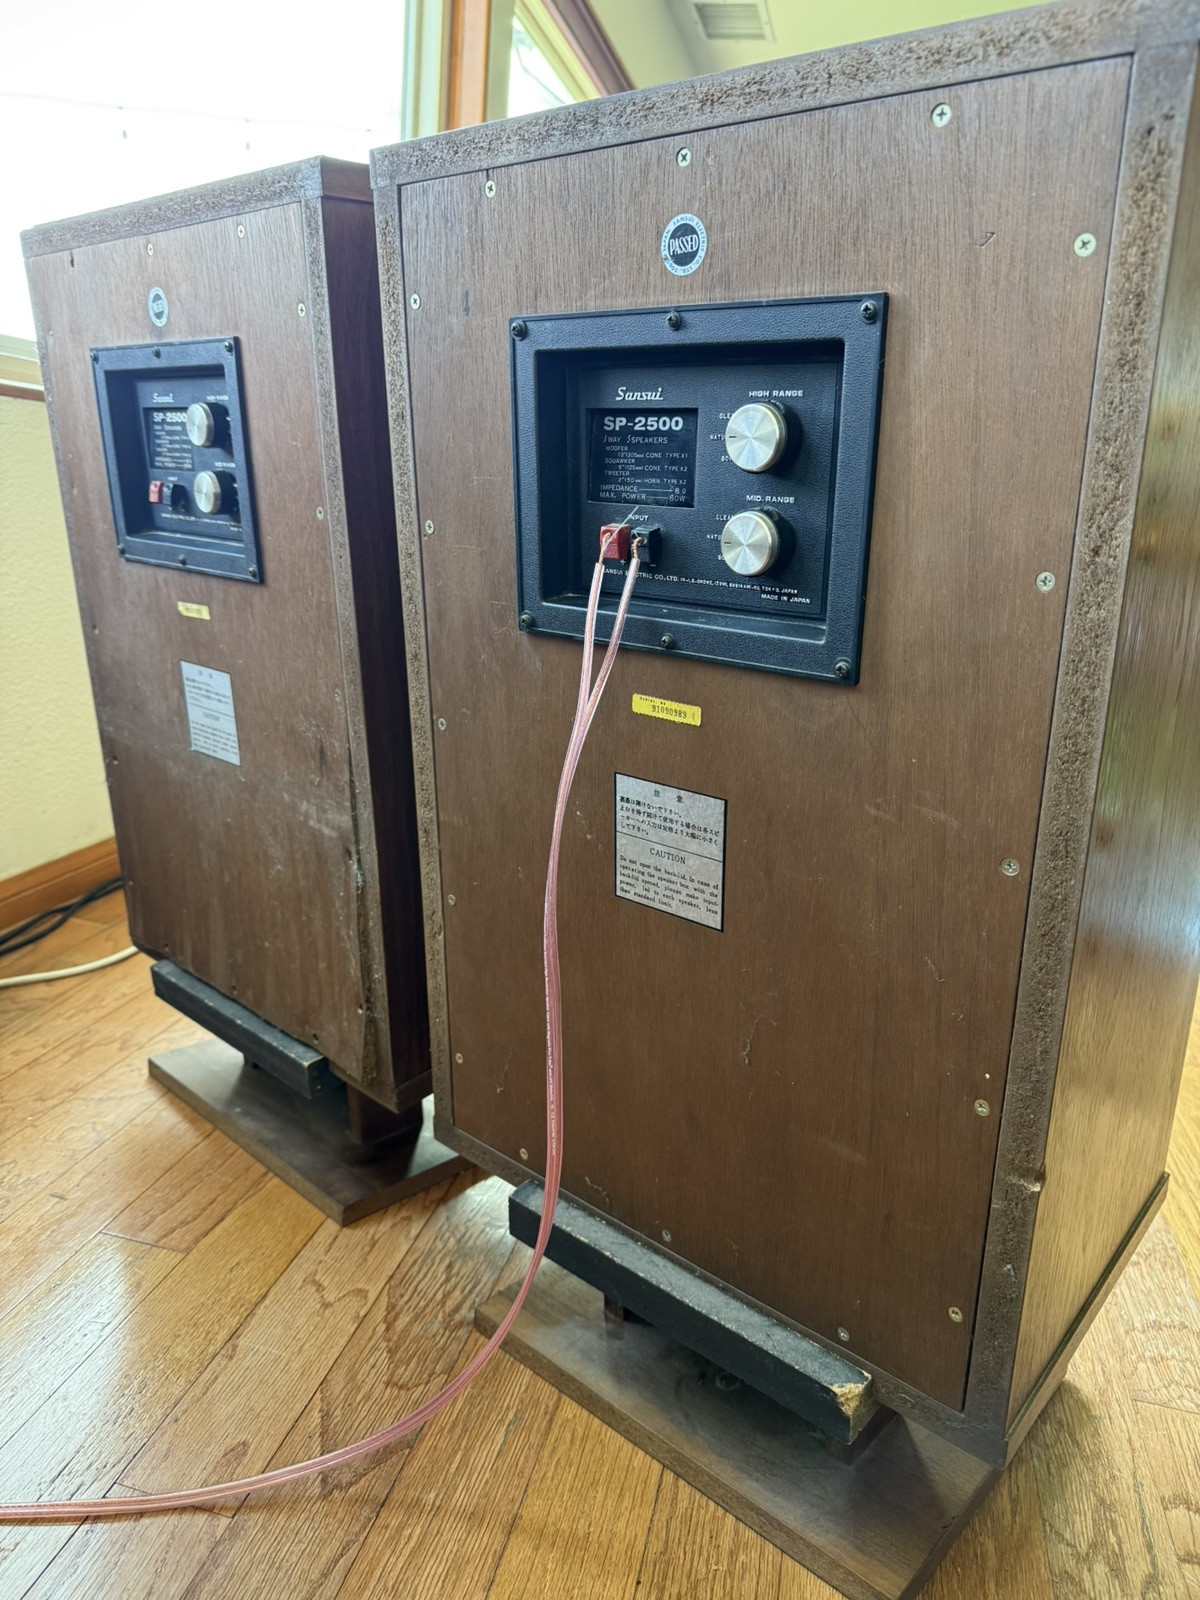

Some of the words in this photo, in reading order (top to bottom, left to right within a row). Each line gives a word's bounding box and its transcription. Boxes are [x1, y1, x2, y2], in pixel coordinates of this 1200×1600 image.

[670, 234, 699, 256] PASSED
[615, 386, 664, 401] Sansui
[772, 389, 804, 397] RANGE
[603, 415, 684, 431] SP-2500
[600, 484, 639, 492] IMPEDANCE
[600, 491, 617, 499] MAX.
[621, 492, 647, 500] POWER
[604, 568, 624, 576] ANSUI
[761, 593, 779, 601] MADE
[649, 847, 687, 865] CAUTION
[620, 854, 627, 862] Do
[639, 862, 651, 870] open
[653, 865, 662, 873] the
[697, 880, 711, 888] case
[619, 864, 646, 877] operating
[657, 876, 679, 886] speaker
[680, 881, 690, 889] box
[693, 886, 706, 895] with
[709, 890, 719, 898] the
[619, 886, 631, 895] than
[633, 891, 656, 903] standard
[664, 885, 683, 896] please
[685, 892, 699, 900] make
[662, 893, 675, 901] each
[705, 905, 719, 915] less
